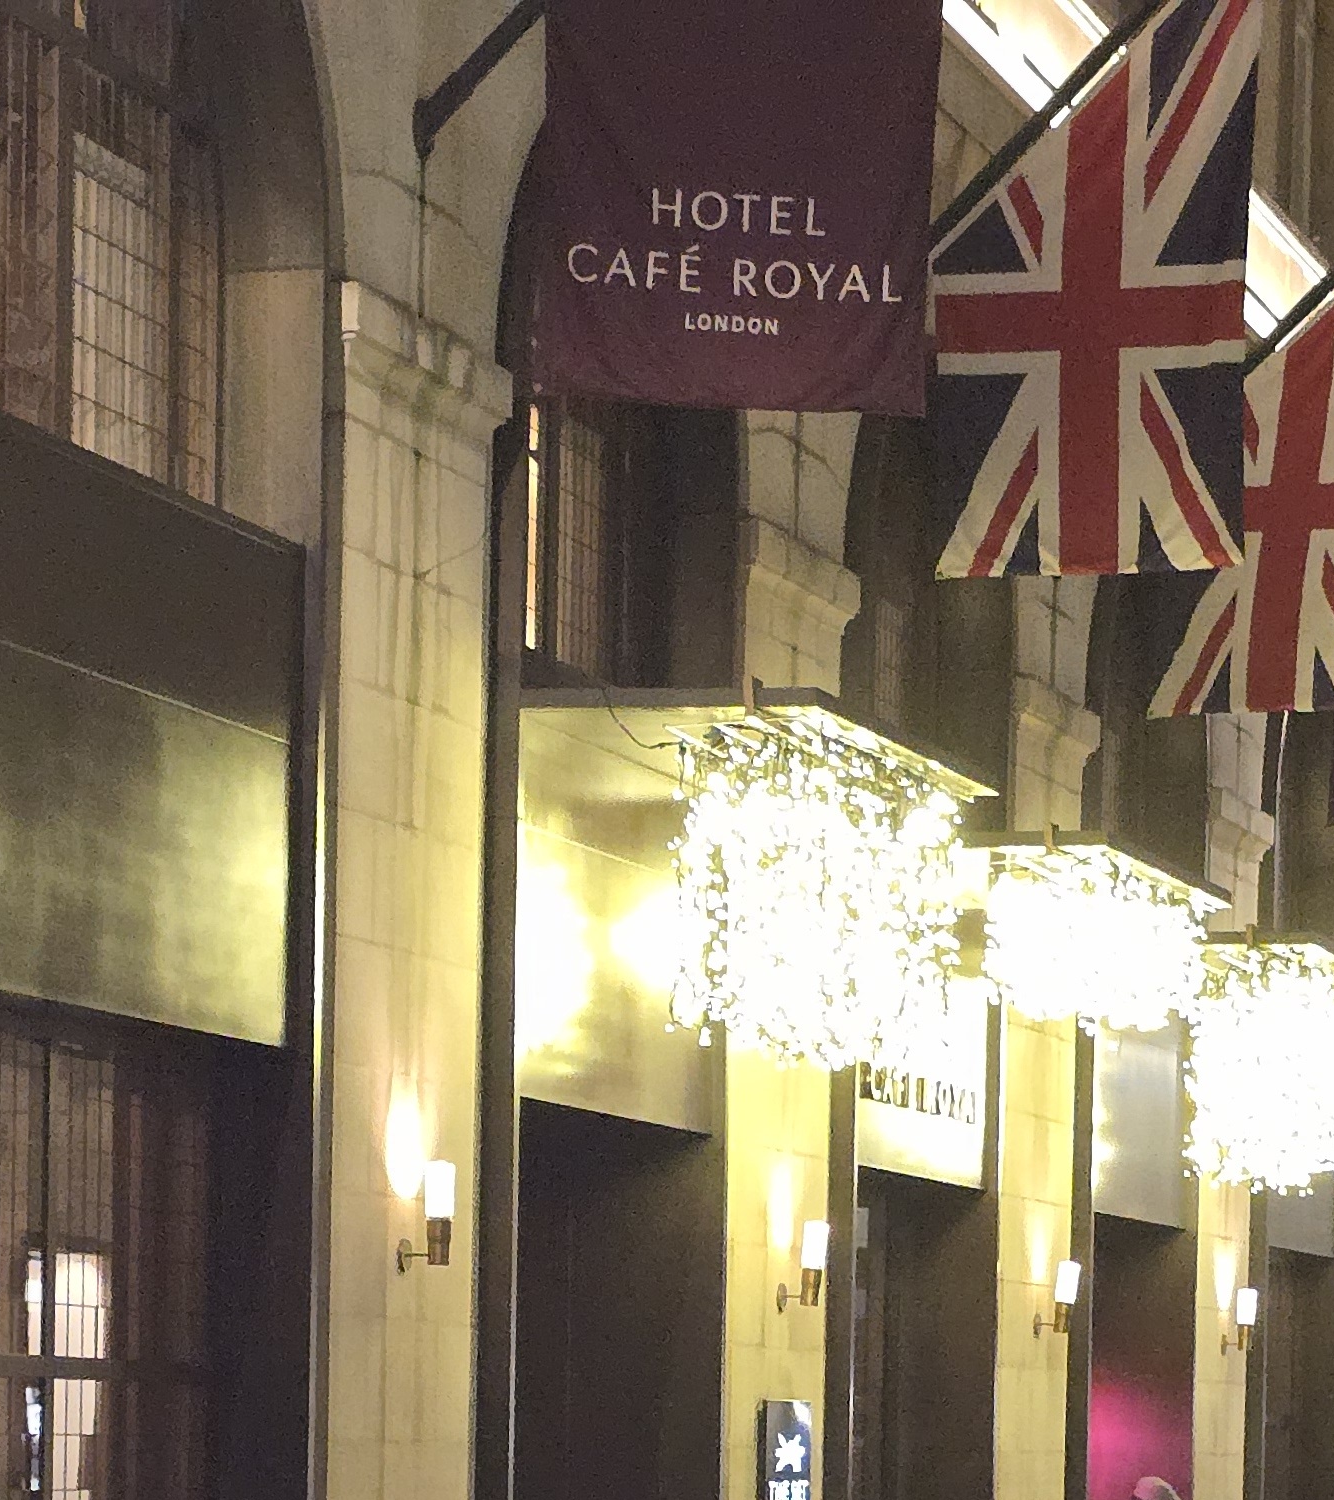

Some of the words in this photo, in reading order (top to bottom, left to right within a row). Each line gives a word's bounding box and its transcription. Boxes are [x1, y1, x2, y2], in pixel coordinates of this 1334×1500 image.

[651, 187, 826, 238] HOTEL
[567, 242, 702, 295] CAFÉ
[732, 258, 903, 303] ROYAL
[684, 311, 780, 336] LONDON
